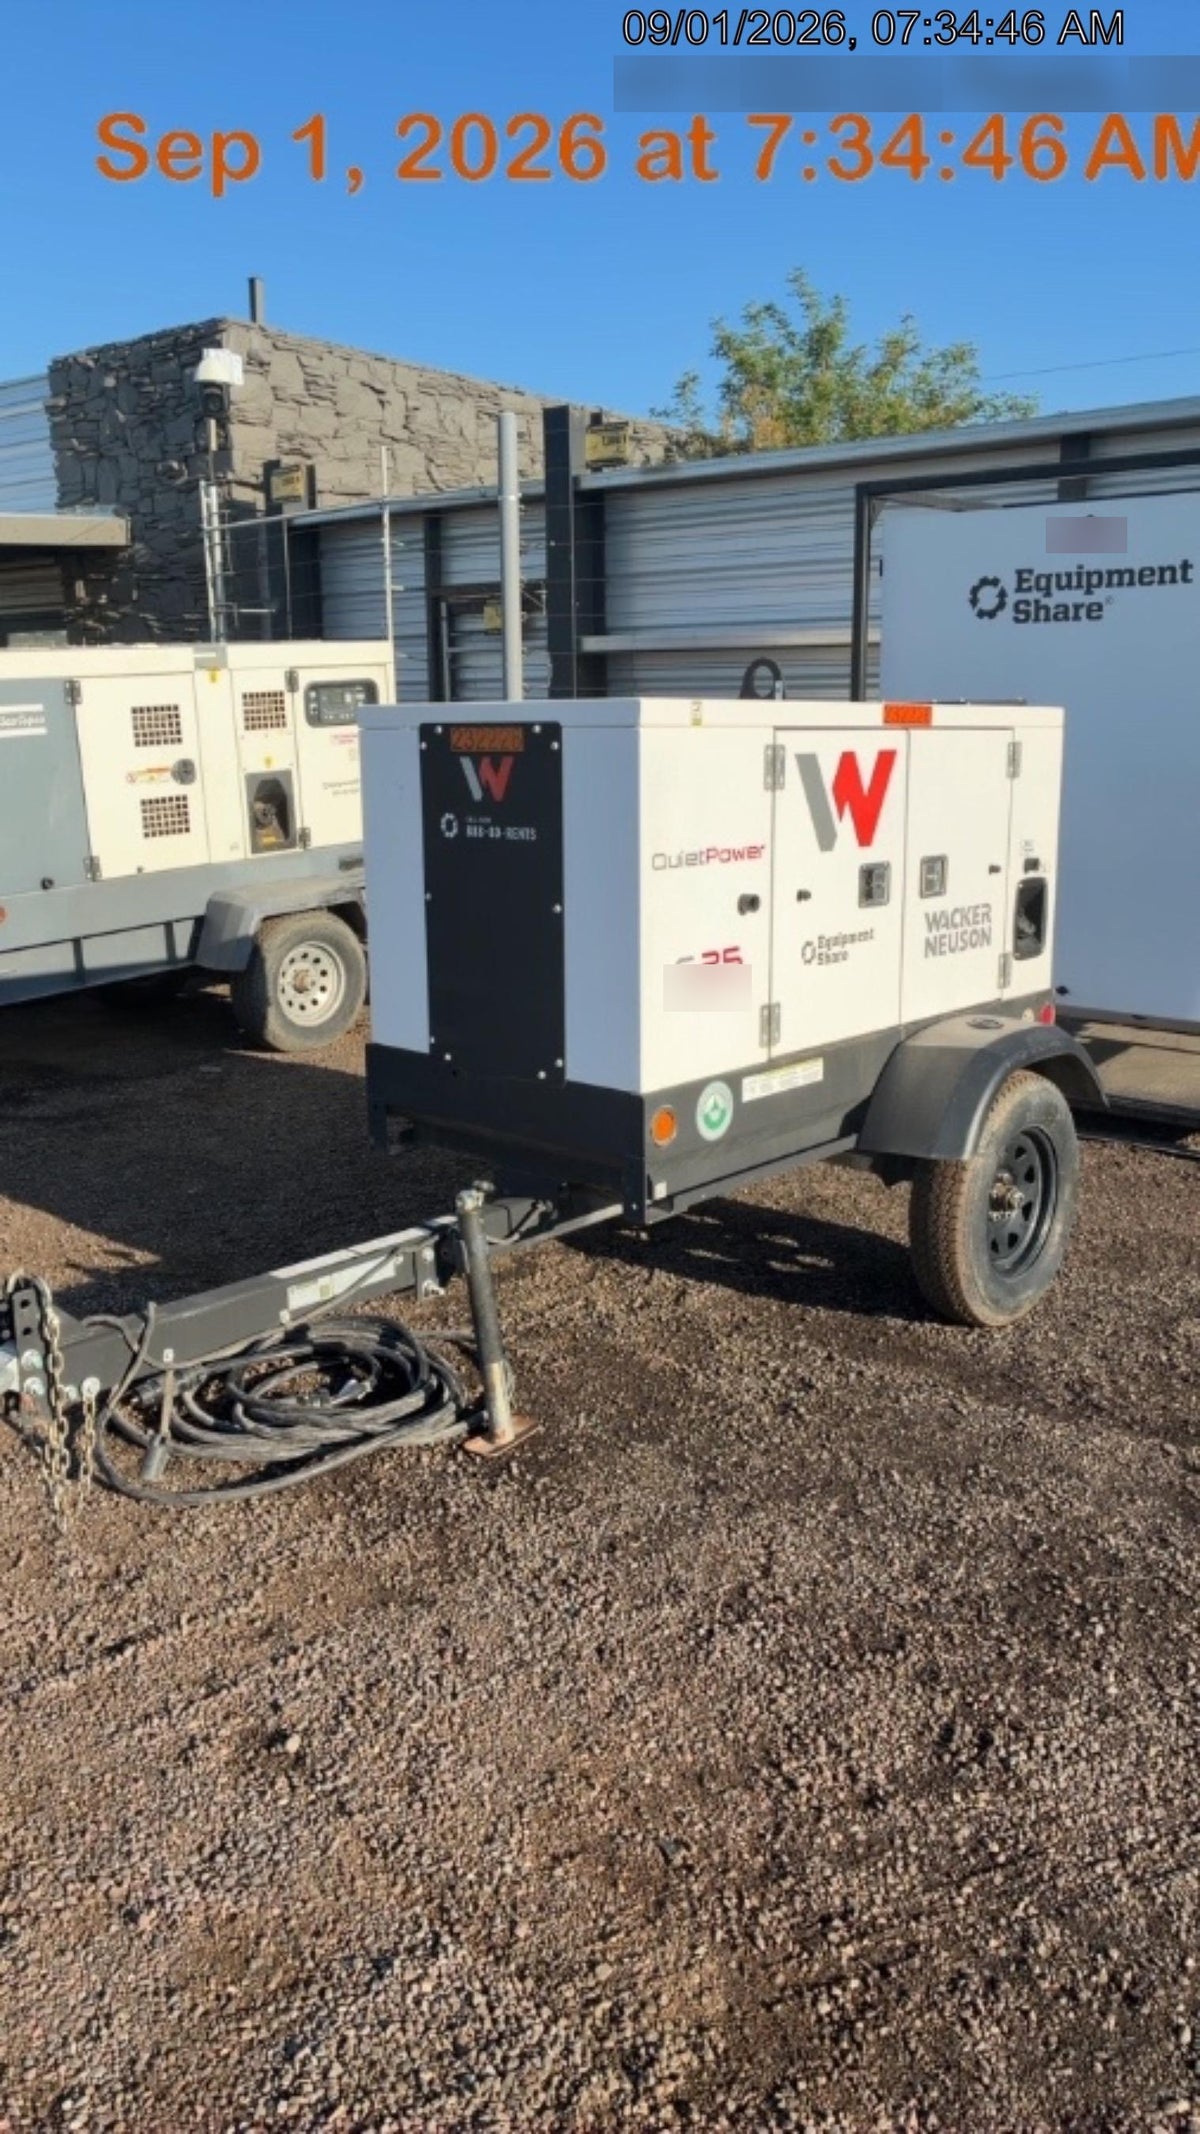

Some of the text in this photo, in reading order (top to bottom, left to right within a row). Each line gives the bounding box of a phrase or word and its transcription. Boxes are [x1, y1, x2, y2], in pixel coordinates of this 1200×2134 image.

[1014, 559, 1194, 598] Equipment
[651, 844, 766, 871] QuietPower
[923, 902, 993, 933] WACKER
[817, 928, 875, 951] Equipment
[923, 925, 993, 959] NEUSON
